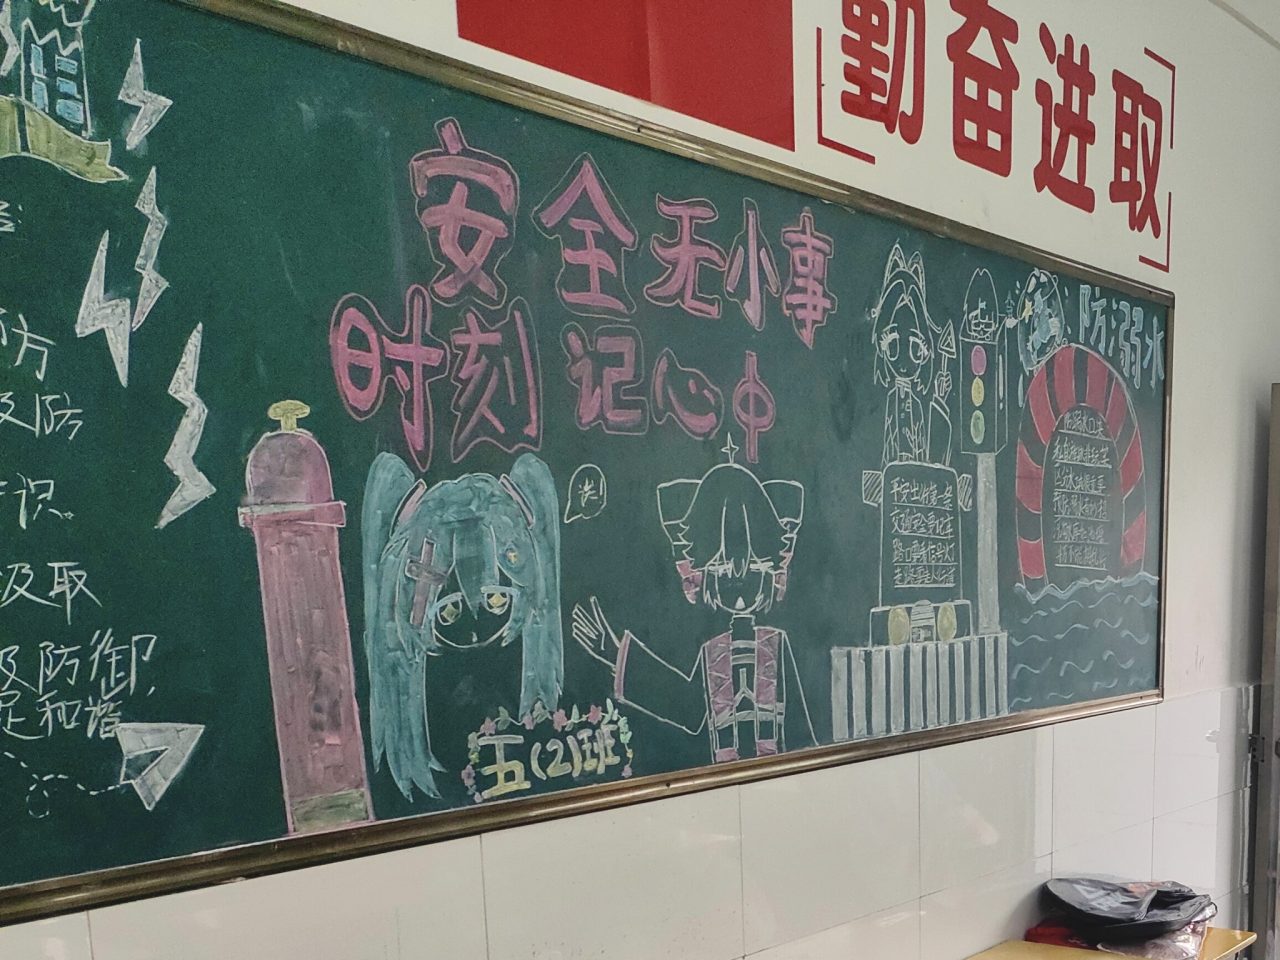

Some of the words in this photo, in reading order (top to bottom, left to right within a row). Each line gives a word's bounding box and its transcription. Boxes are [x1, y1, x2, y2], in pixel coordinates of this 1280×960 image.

[841, 0, 1163, 240] 勤奋进取
[409, 117, 838, 350] 安全无小事
[329, 284, 777, 472] 时刻记心中
[1079, 284, 1164, 390] 防溺水
[476, 724, 621, 800] 五(2)班
